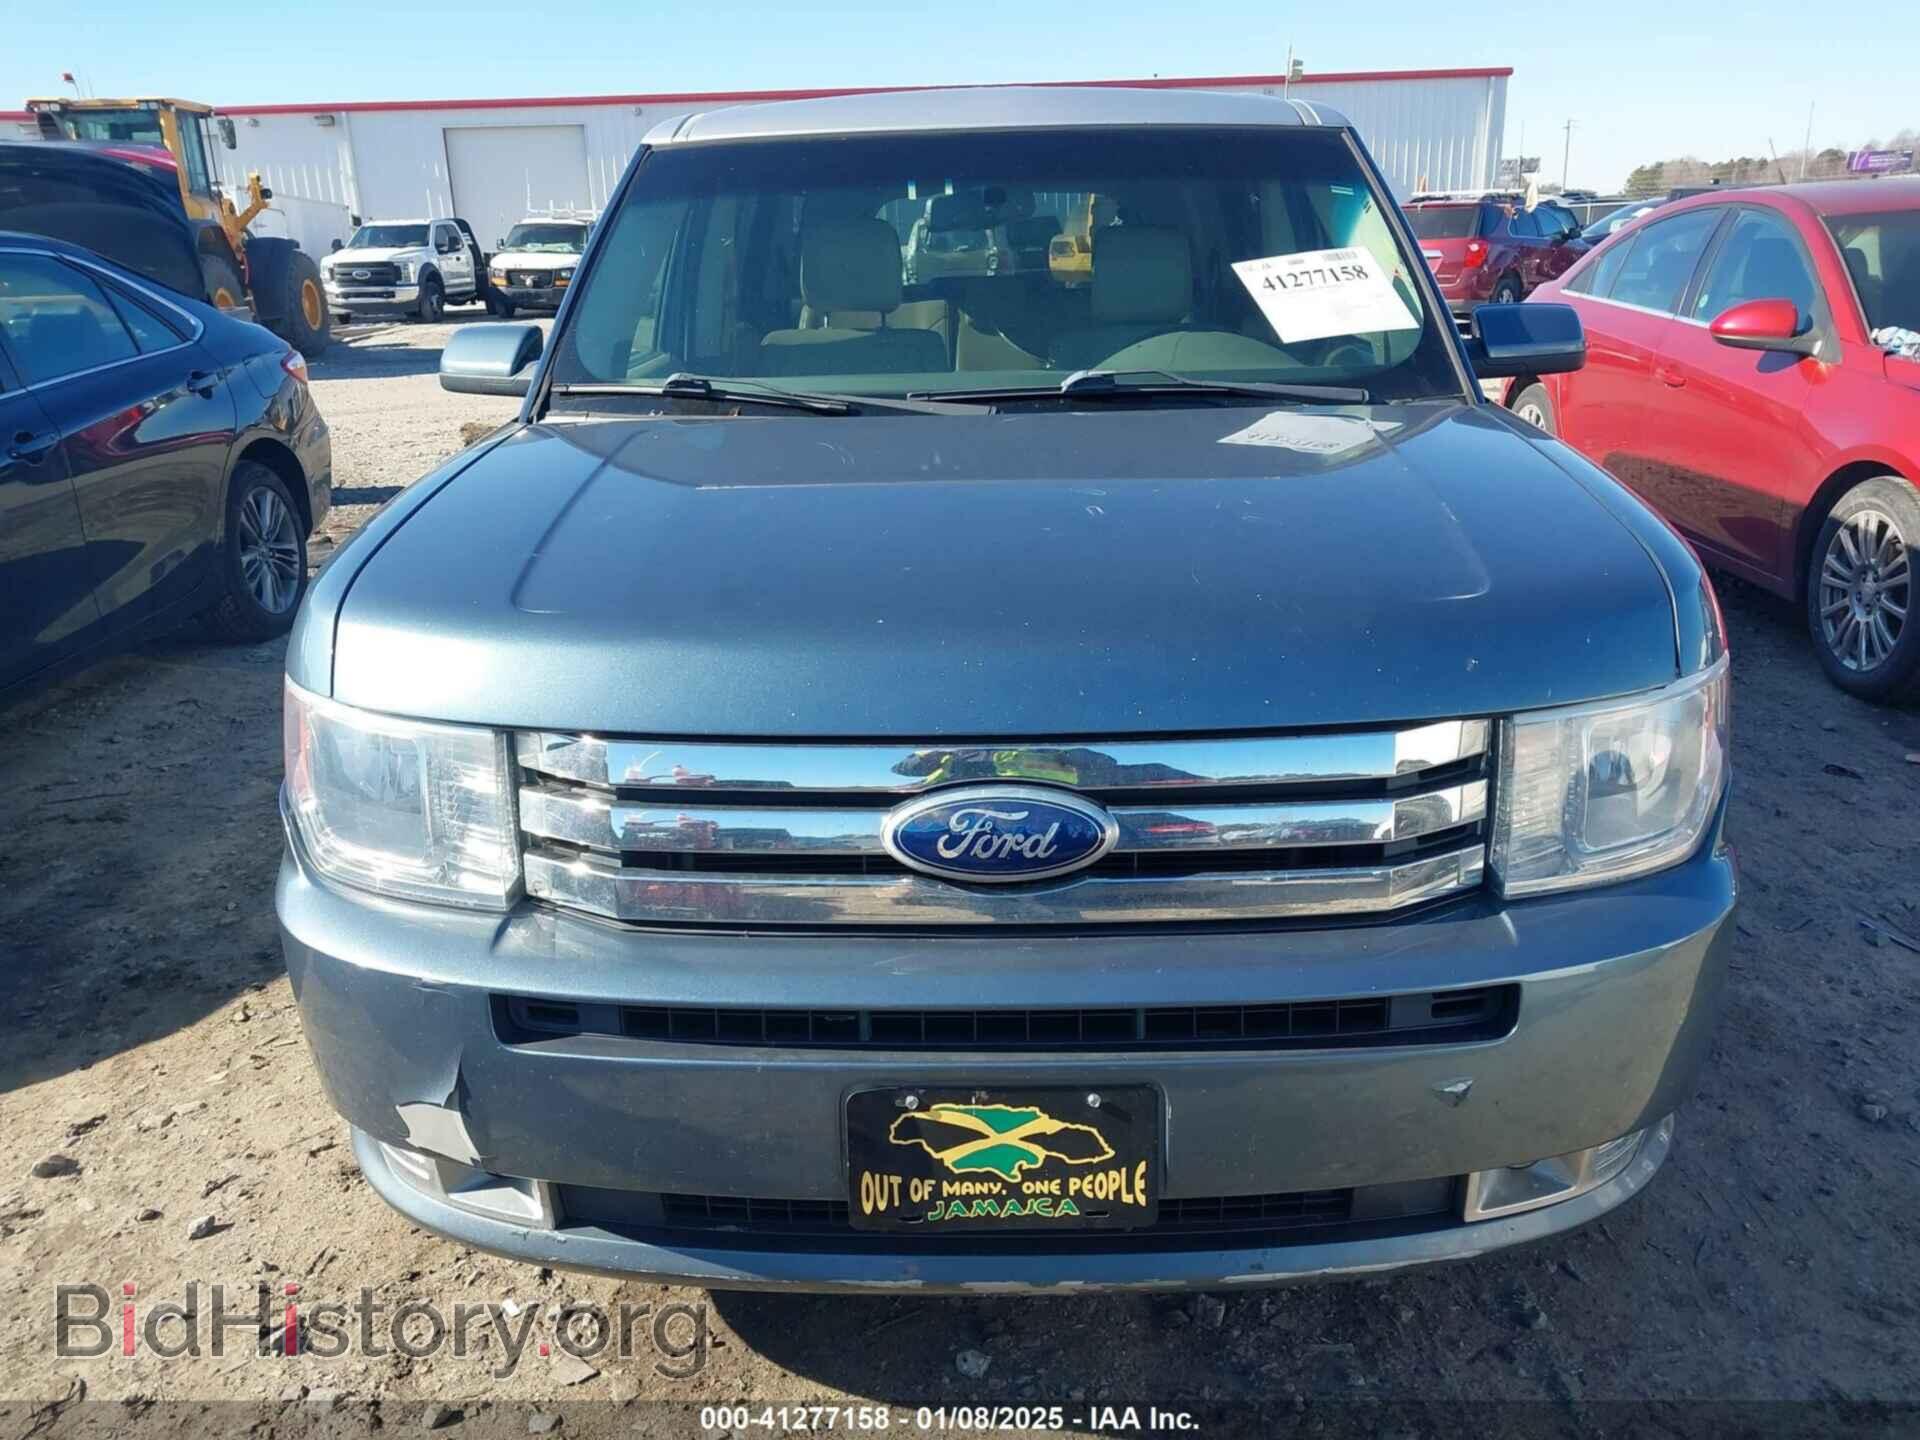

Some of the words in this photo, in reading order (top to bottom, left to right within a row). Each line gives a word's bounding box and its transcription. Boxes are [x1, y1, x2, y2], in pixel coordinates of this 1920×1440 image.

[1262, 264, 1369, 291] 41277158
[937, 808, 1060, 859] Ford
[860, 1170, 902, 1215] OUT
[909, 1177, 936, 1203] OF
[1021, 1177, 1061, 1195] ONE
[1069, 1160, 1147, 1207] PEOPLE
[928, 1198, 1080, 1221] JAMAICA
